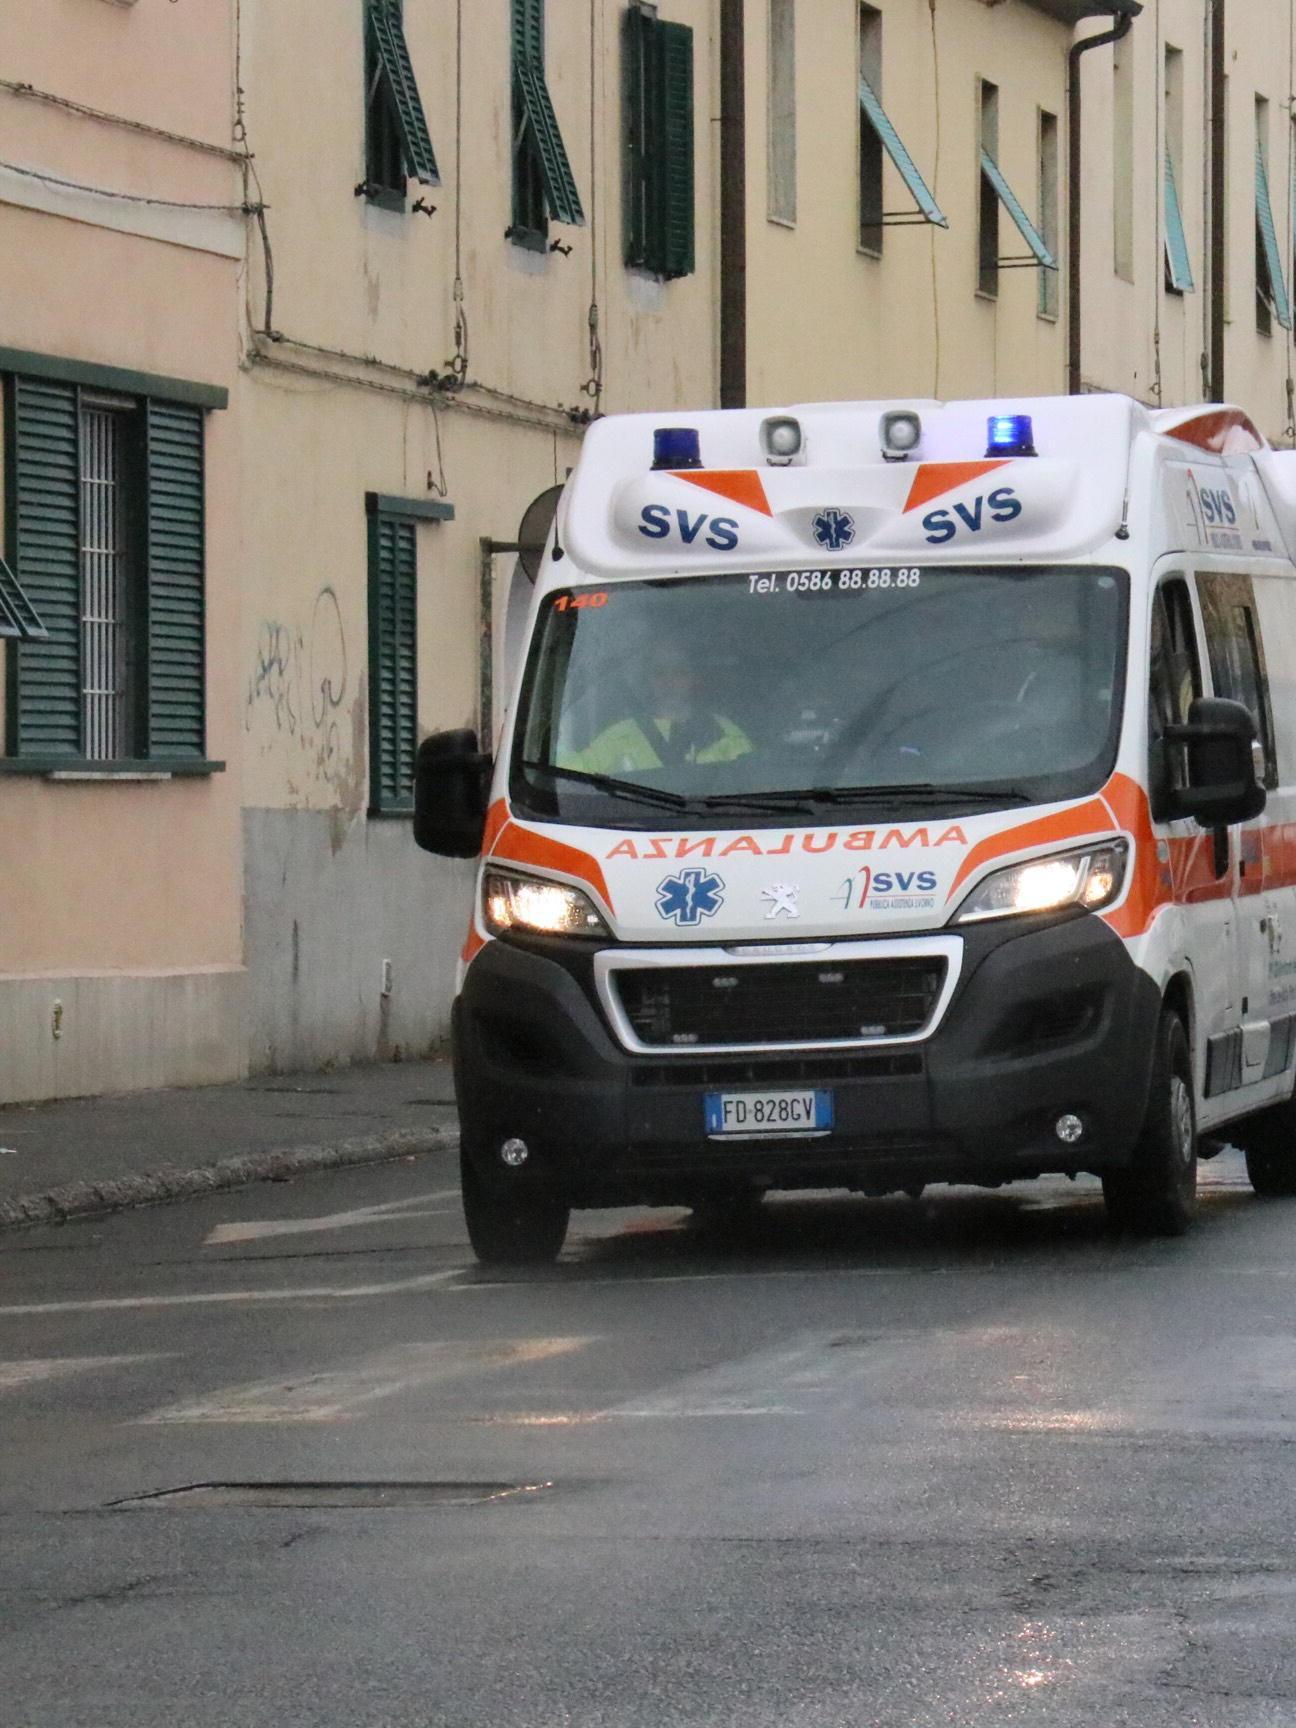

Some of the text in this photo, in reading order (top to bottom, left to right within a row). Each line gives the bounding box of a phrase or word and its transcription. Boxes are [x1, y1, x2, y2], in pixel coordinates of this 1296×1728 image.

[921, 486, 1023, 544] SVS
[1200, 487, 1236, 525] SVS
[638, 504, 740, 551] SVS
[749, 568, 921, 594] Tel. 0586 88.88.88
[872, 871, 937, 892] SVS
